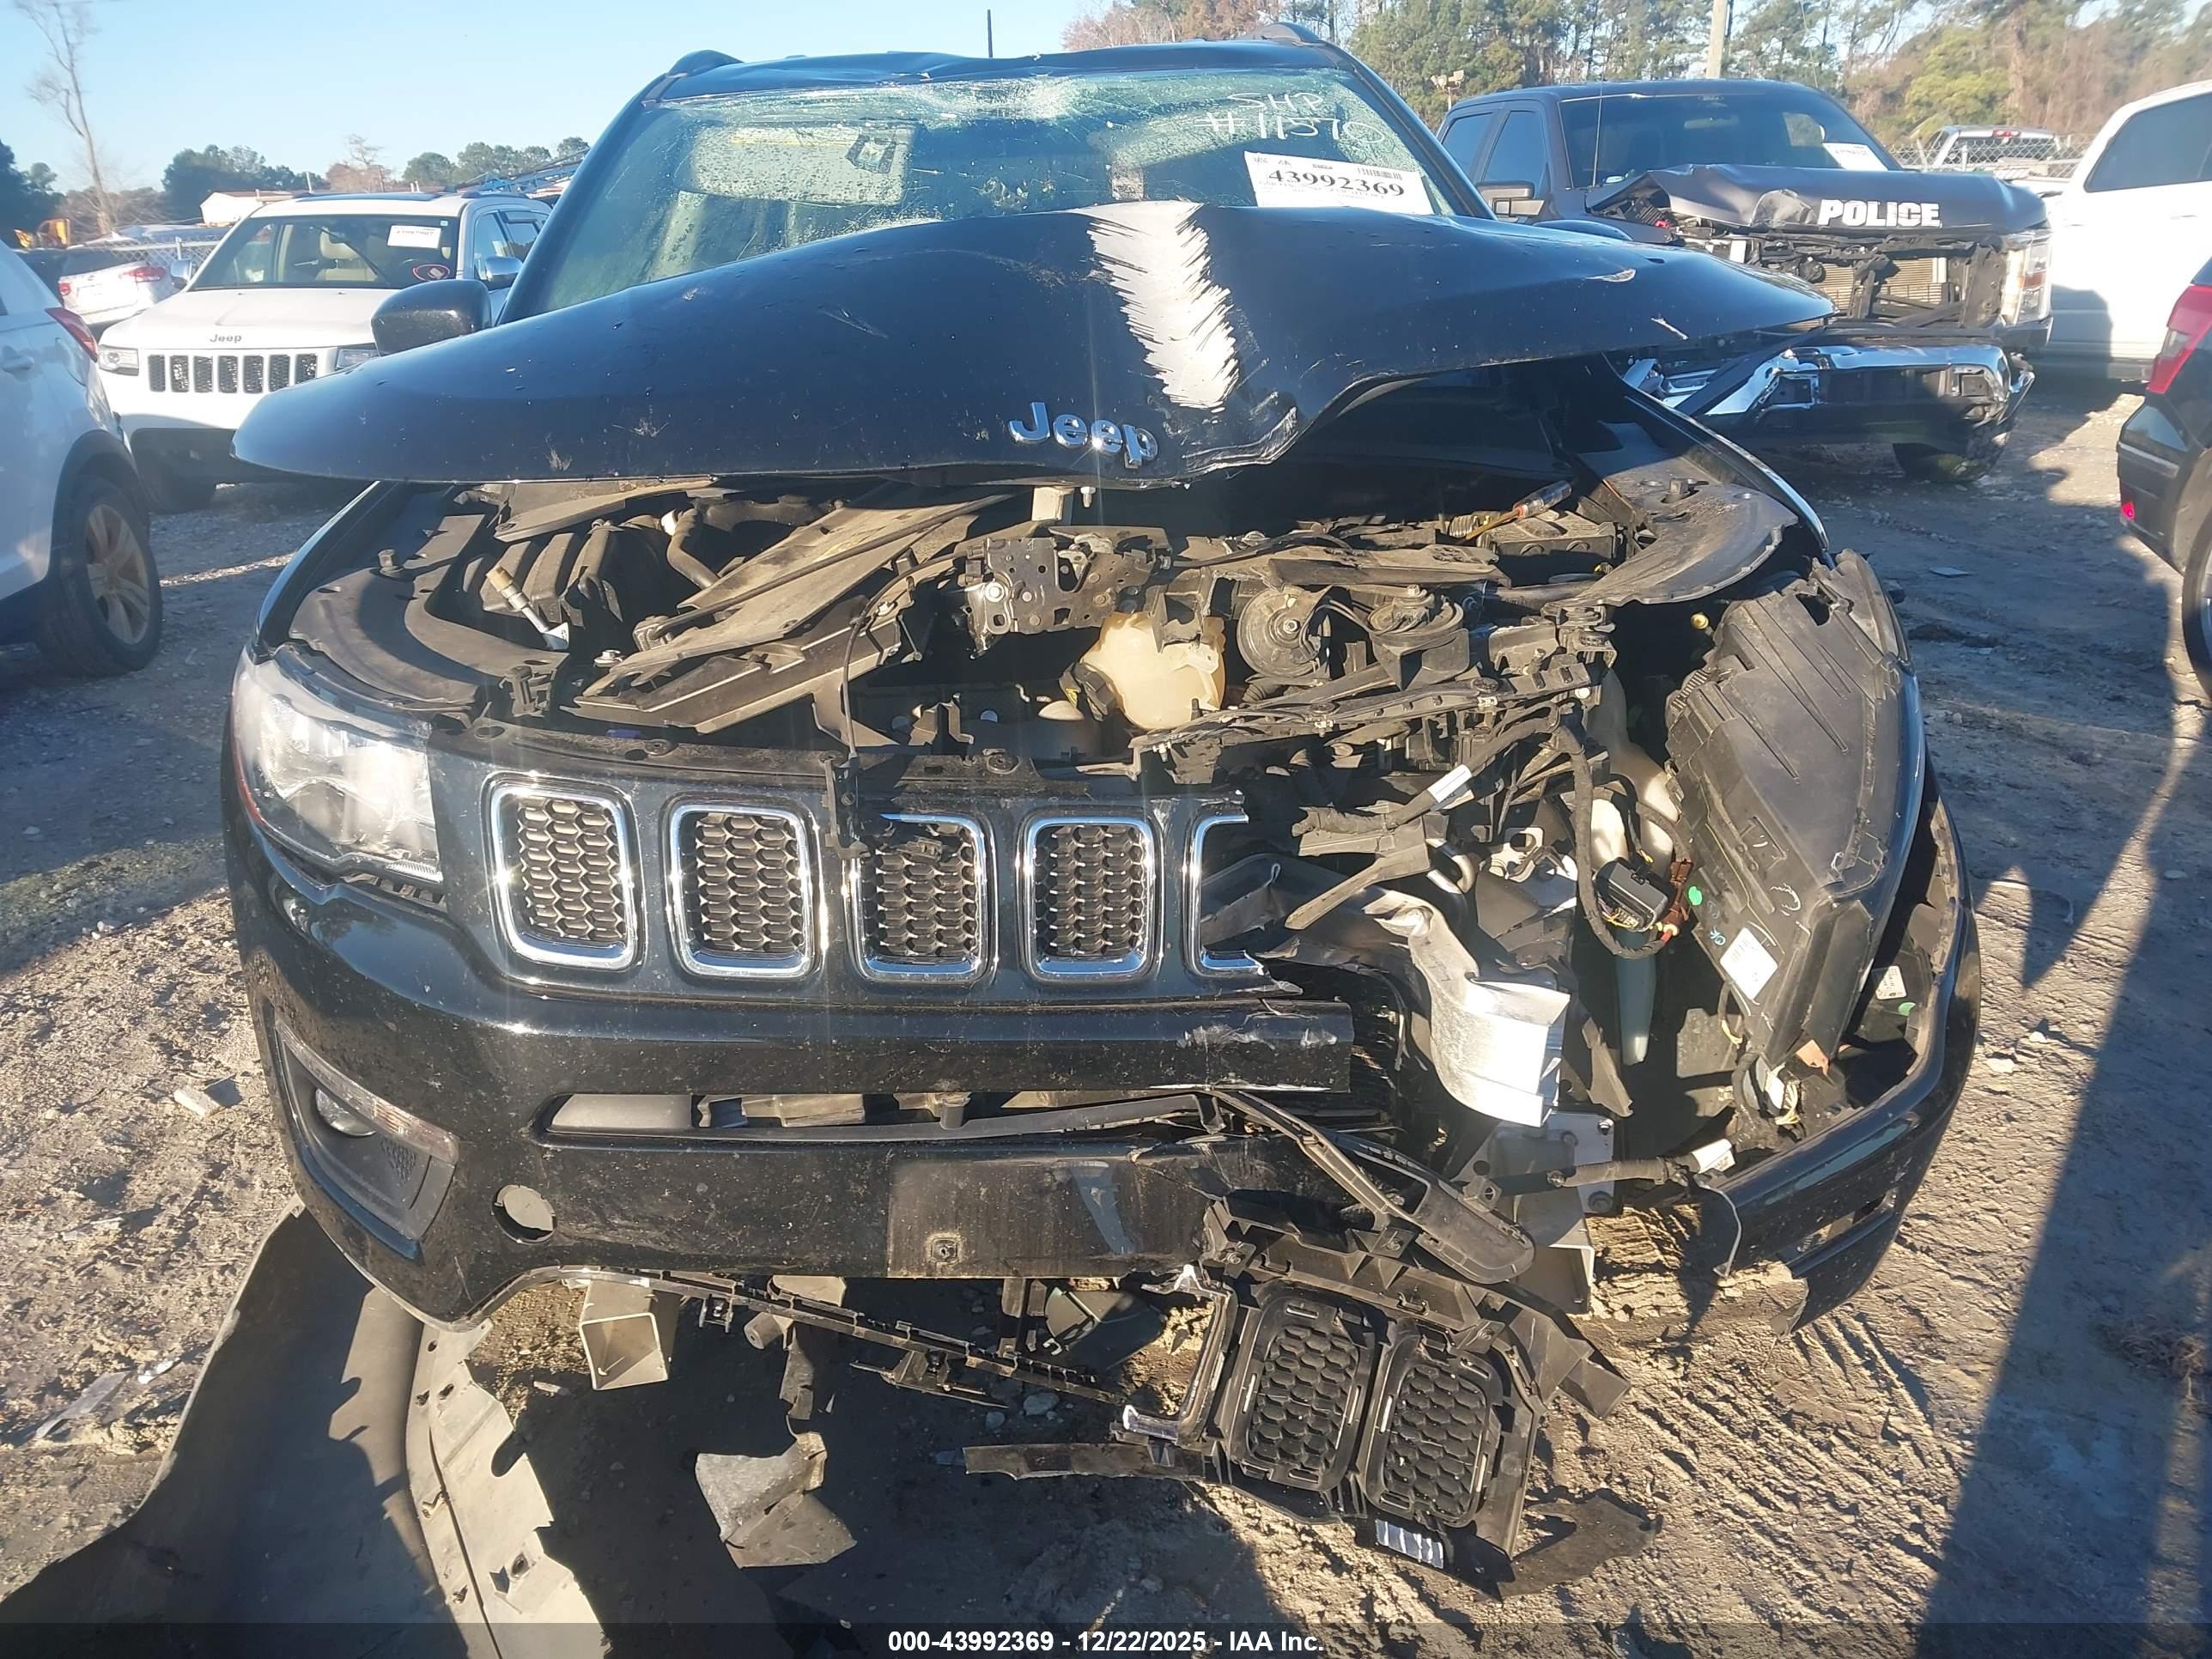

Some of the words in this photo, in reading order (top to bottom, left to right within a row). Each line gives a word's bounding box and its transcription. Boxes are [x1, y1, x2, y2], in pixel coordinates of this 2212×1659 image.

[1268, 169, 1405, 197] 43992369
[1817, 198, 1942, 228] POLICE
[209, 333, 242, 343] Jeep
[1008, 401, 1158, 469] Jeep
